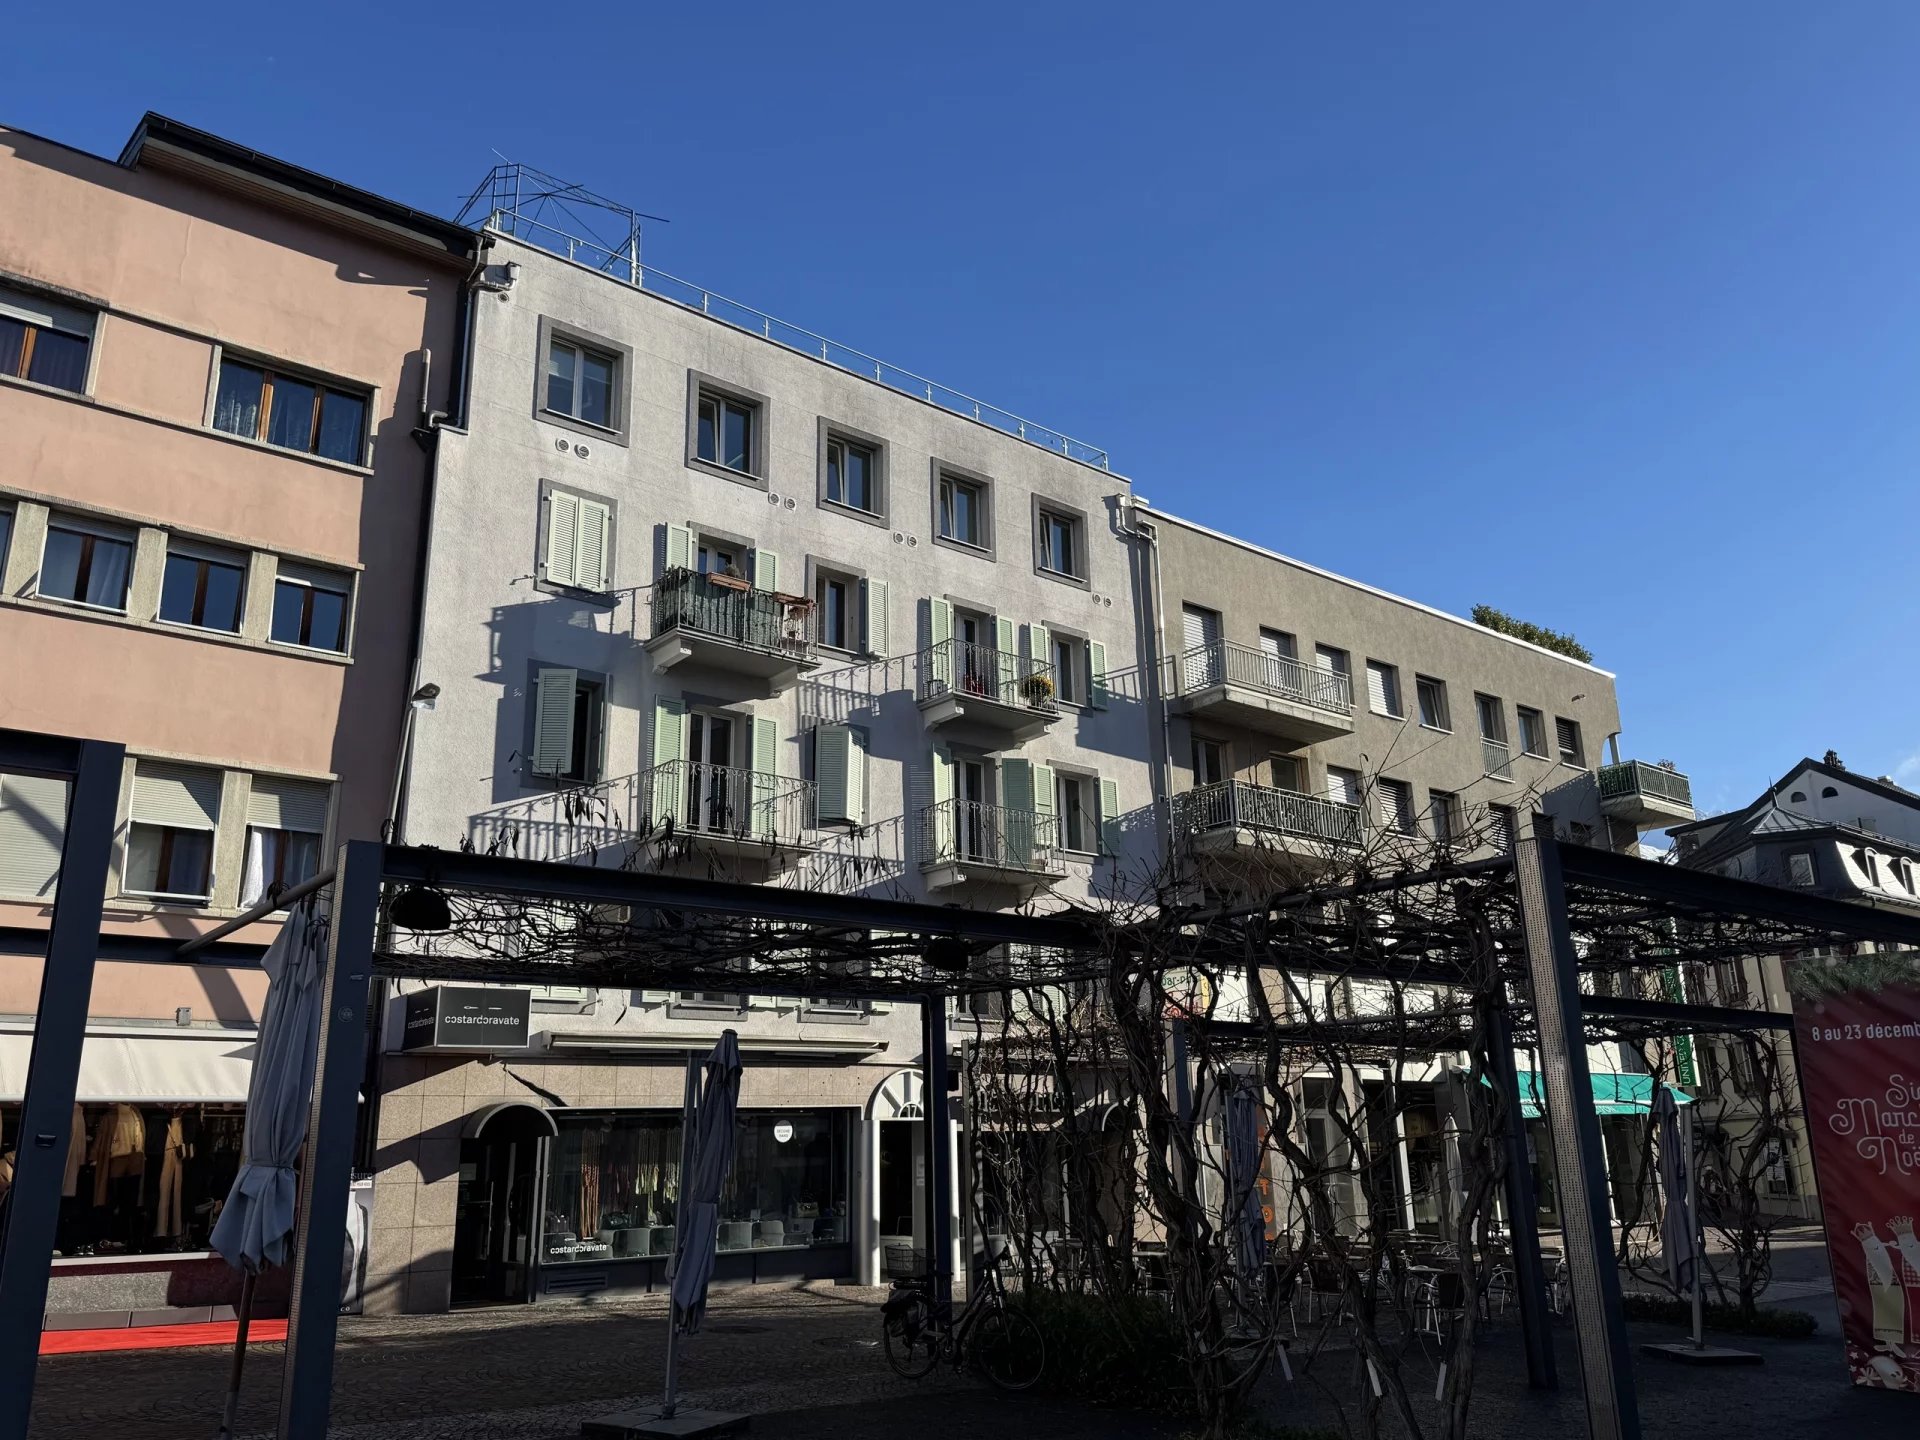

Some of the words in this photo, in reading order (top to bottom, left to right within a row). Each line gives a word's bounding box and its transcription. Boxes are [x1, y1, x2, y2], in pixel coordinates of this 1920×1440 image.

[1811, 1026, 1820, 1042] 8
[1824, 1027, 1841, 1041] au
[1844, 1024, 1862, 1040] 23
[1898, 1128, 1915, 1145] de
